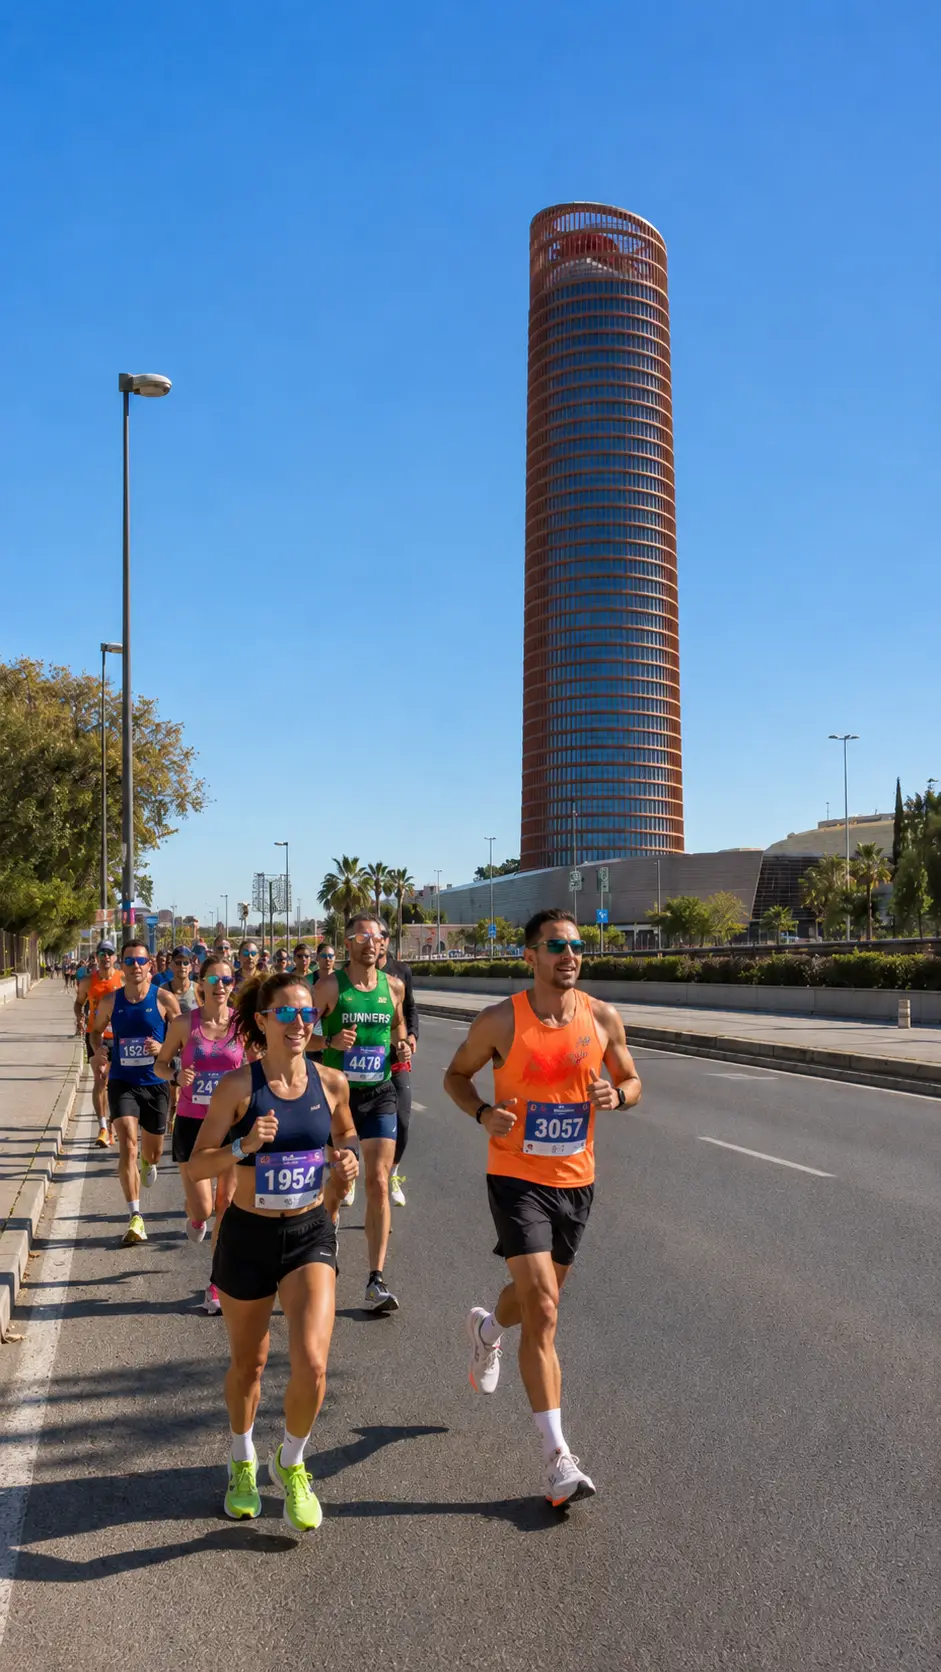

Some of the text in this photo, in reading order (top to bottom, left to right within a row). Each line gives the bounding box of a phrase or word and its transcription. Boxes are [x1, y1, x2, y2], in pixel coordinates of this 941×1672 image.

[342, 1012, 391, 1024] RUNNERS
[349, 1056, 381, 1070] 4478
[534, 1117, 584, 1139] 3057
[264, 1166, 316, 1191] 1954
